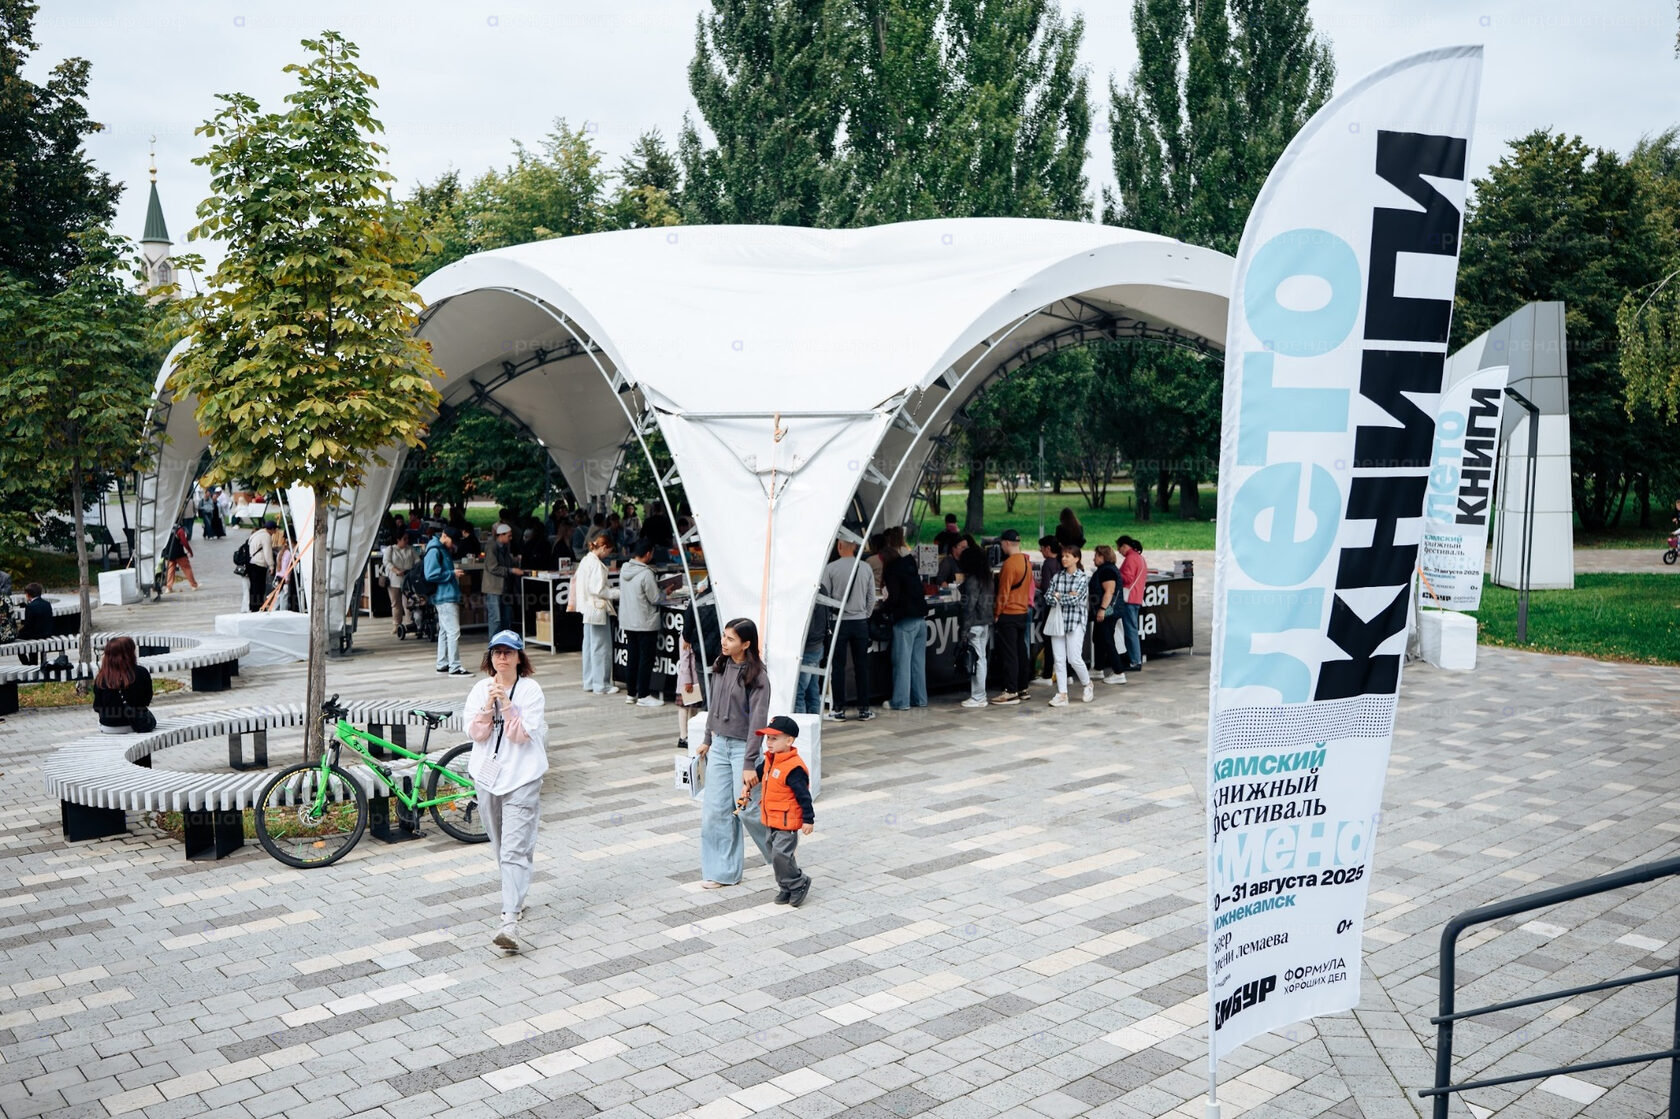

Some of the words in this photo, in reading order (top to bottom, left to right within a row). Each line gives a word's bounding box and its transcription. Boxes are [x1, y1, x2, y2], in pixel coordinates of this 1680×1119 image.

[1214, 742, 1328, 783] камский
[1249, 873, 1318, 897] августа
[1321, 864, 1366, 886] 2025
[1336, 918, 1354, 935] 0+
[1283, 956, 1347, 983] ФОРМУЛА
[1283, 975, 1327, 996] ХОРОШИХ
[1327, 970, 1348, 986] ДЕЛ
